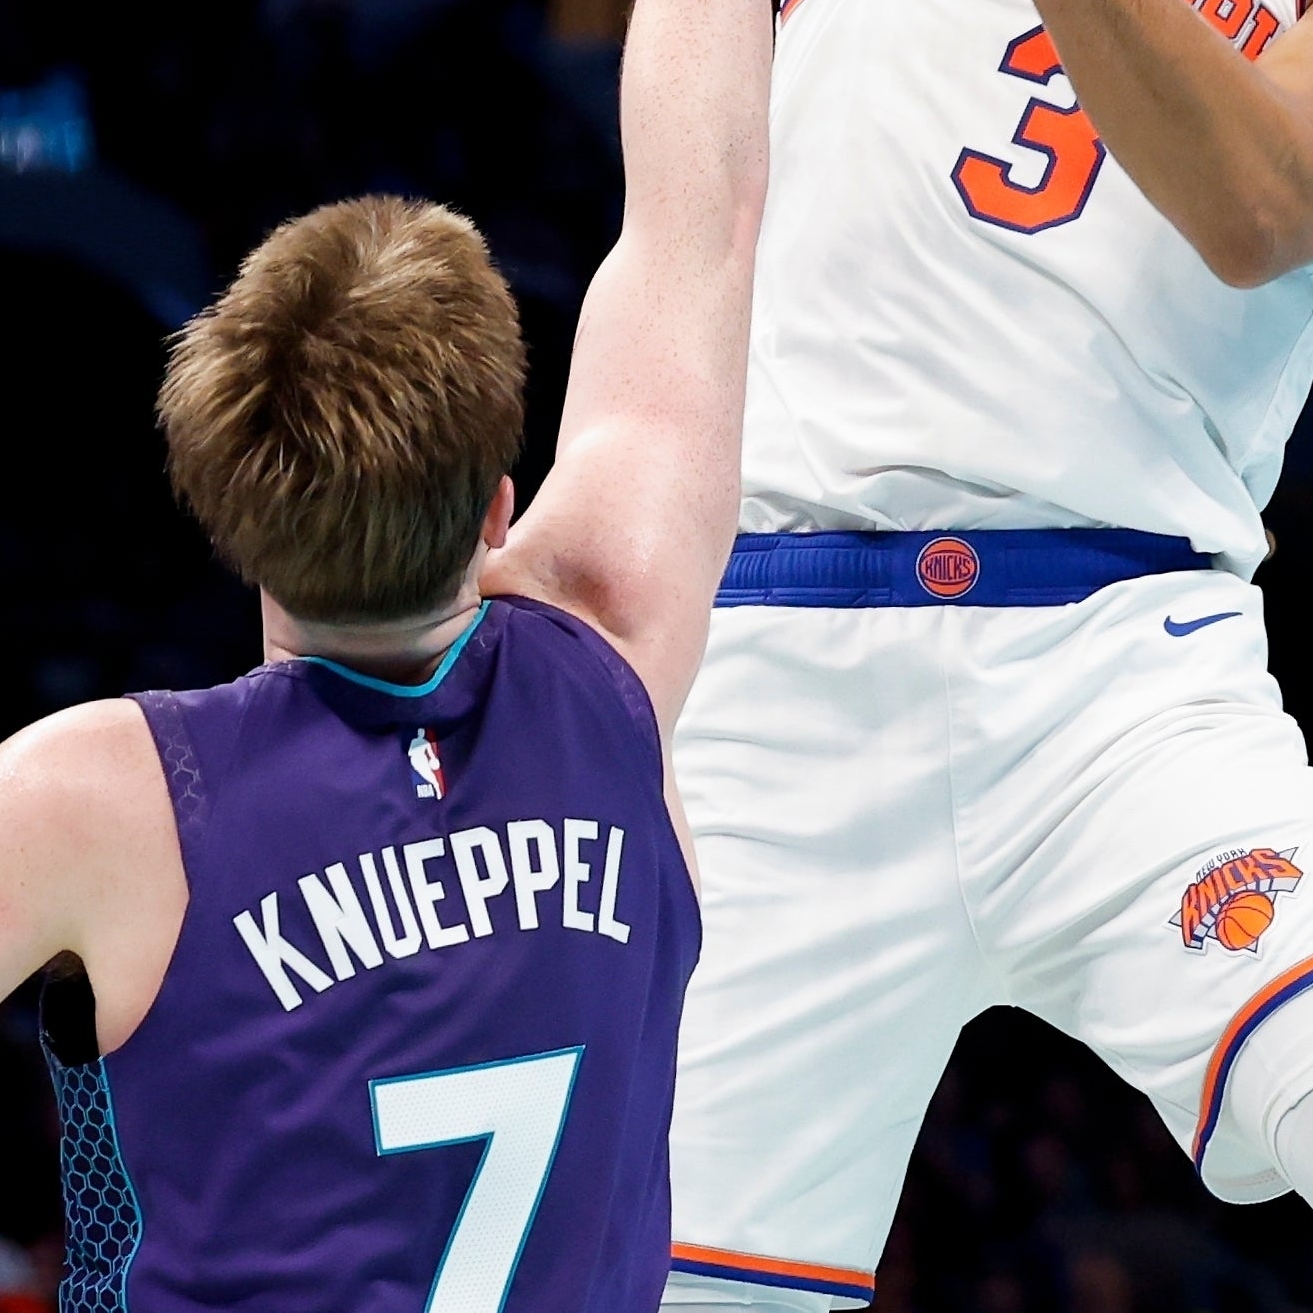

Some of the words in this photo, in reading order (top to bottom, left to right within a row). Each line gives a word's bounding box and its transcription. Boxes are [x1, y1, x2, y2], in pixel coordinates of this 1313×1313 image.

[951, 23, 1106, 234] 3
[925, 554, 971, 581] KNICKS
[233, 818, 630, 1012] KNUEPPEL
[1181, 848, 1303, 948] KNICKS
[1196, 858, 1216, 884] NEW
[1216, 847, 1247, 864] YORK
[368, 1044, 586, 1313] 7
